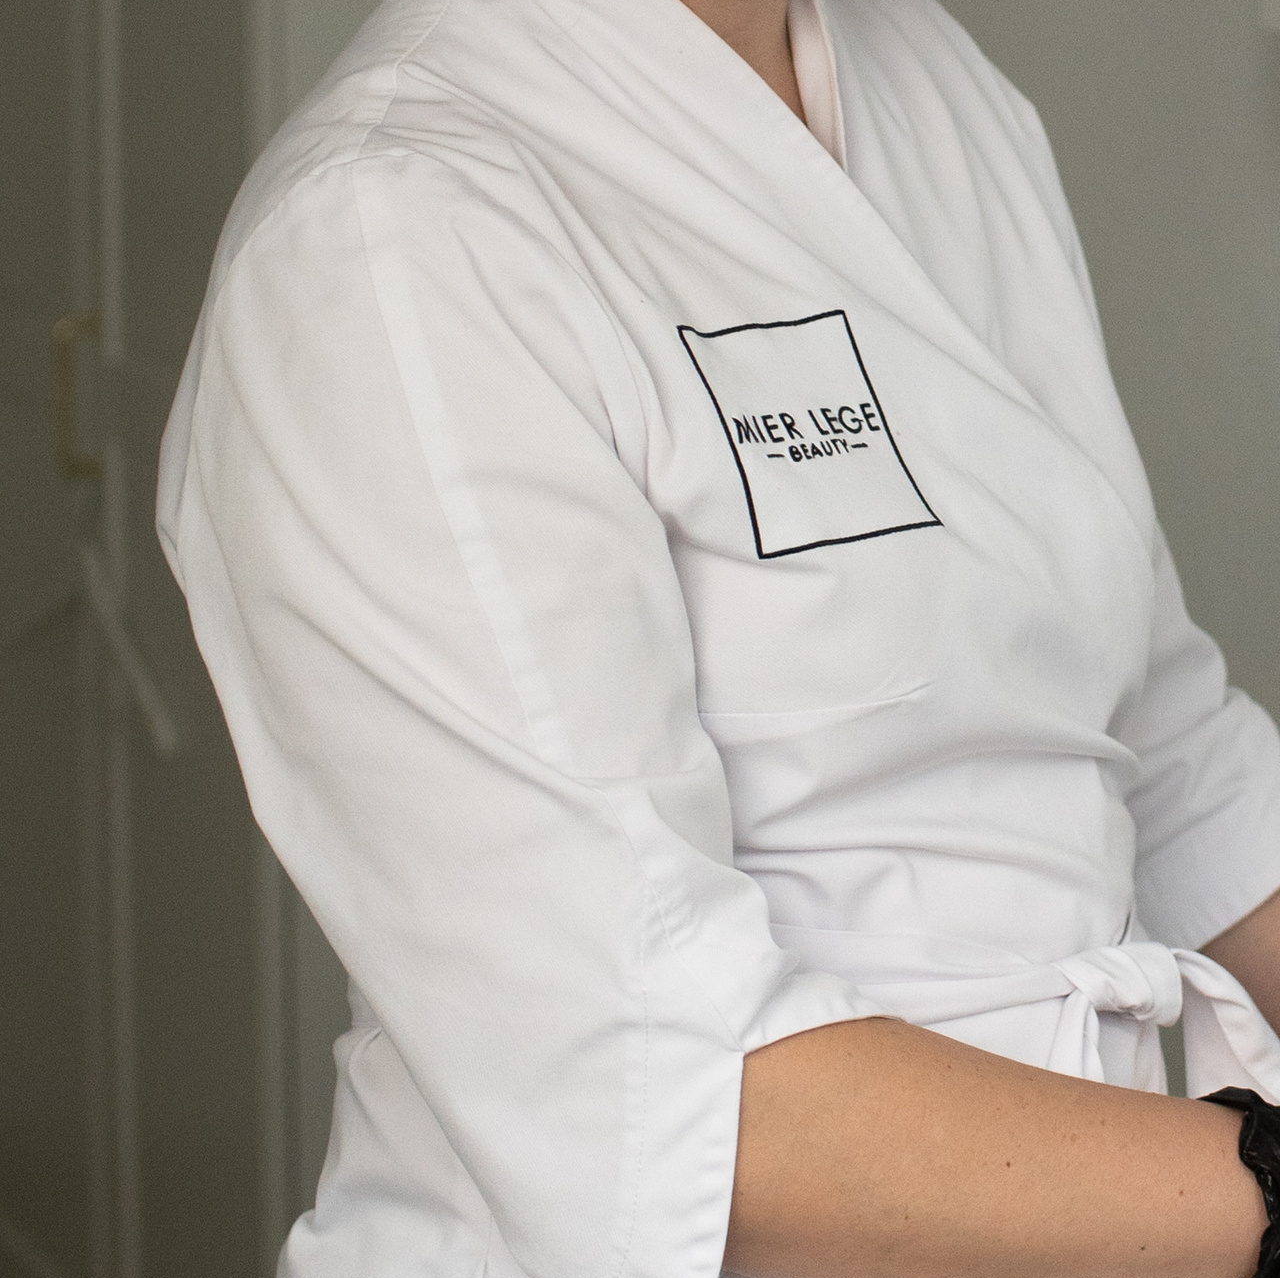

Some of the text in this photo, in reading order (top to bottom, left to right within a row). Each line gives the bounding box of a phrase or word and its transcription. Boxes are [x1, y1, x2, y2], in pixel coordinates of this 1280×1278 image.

[732, 402, 881, 444] MIER LEGE
[788, 438, 850, 462] BEAUTY
